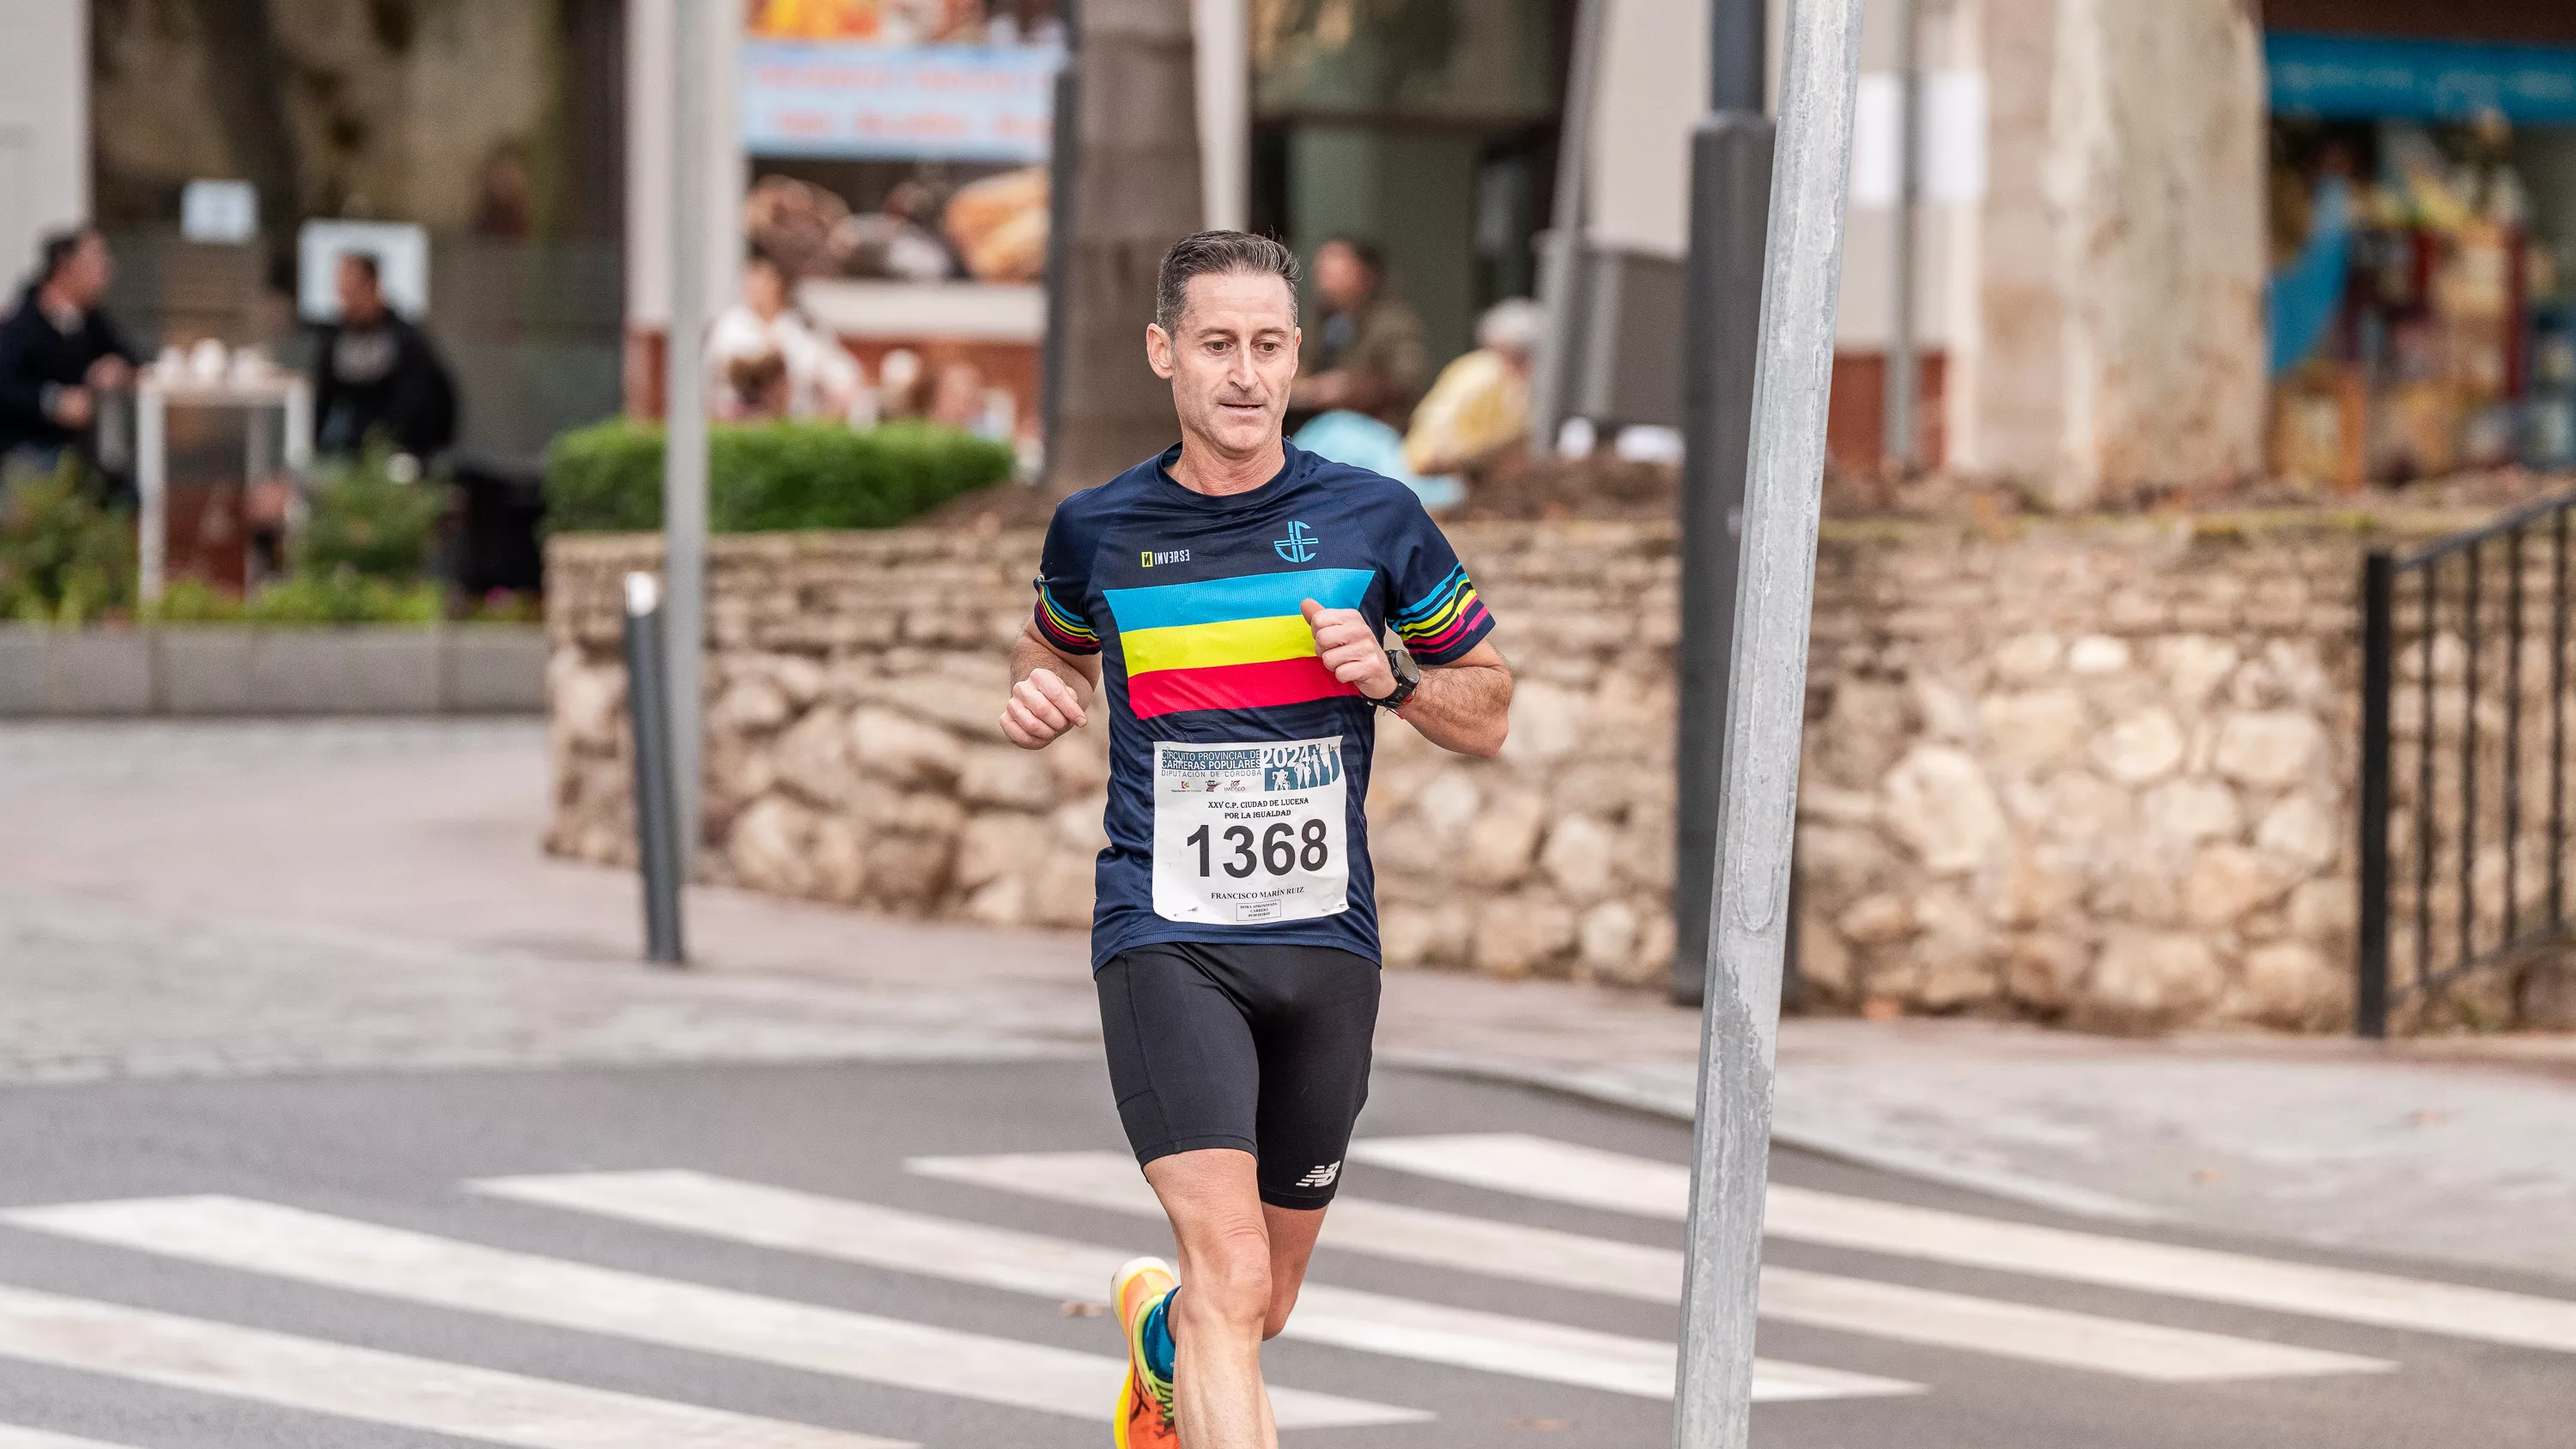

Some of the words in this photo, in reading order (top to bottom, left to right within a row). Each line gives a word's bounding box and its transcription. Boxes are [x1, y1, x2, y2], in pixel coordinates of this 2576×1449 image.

[1162, 750, 1196, 761] CIRCUITO
[1198, 750, 1248, 761] PROVINCIAL
[1250, 750, 1261, 760] DE
[1264, 744, 1311, 768] 2024
[1162, 759, 1206, 770] CARRERAS
[1208, 759, 1261, 770] POPULARES
[1280, 797, 1309, 806] LUCENA
[1253, 809, 1291, 819] IGUALDAD
[1187, 819, 1328, 879] 1368
[1259, 888, 1285, 898] MARÍN
[1286, 886, 1304, 894] RUIZ
